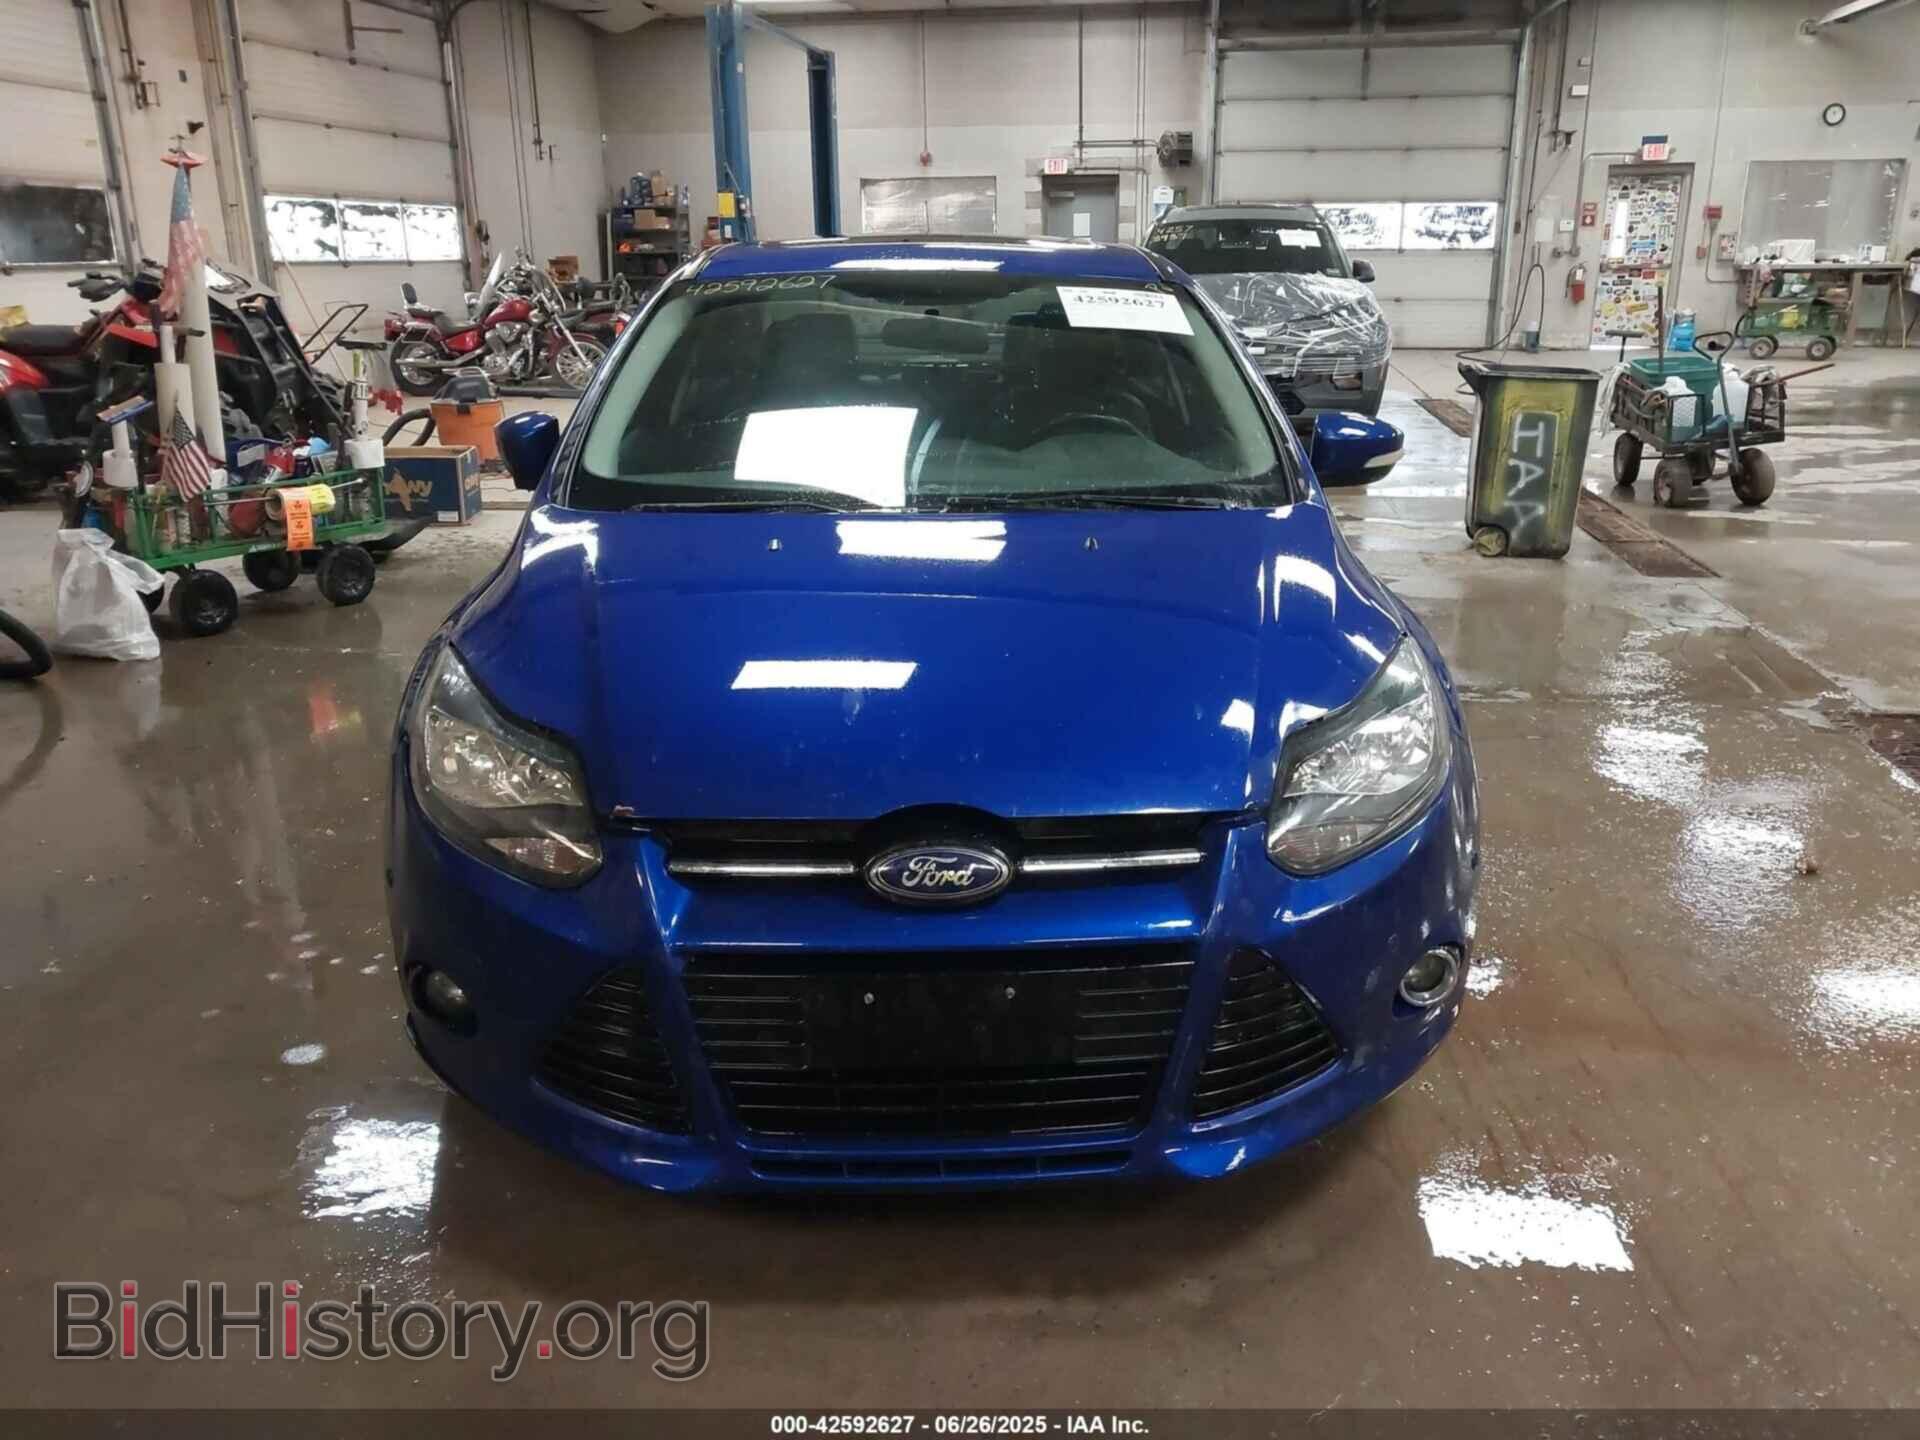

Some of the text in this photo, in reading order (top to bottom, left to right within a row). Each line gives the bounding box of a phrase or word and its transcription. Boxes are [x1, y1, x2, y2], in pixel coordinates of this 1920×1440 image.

[686, 274, 837, 296] 42592627
[1074, 295, 1165, 309] 42592627
[902, 856, 977, 887] Ford
